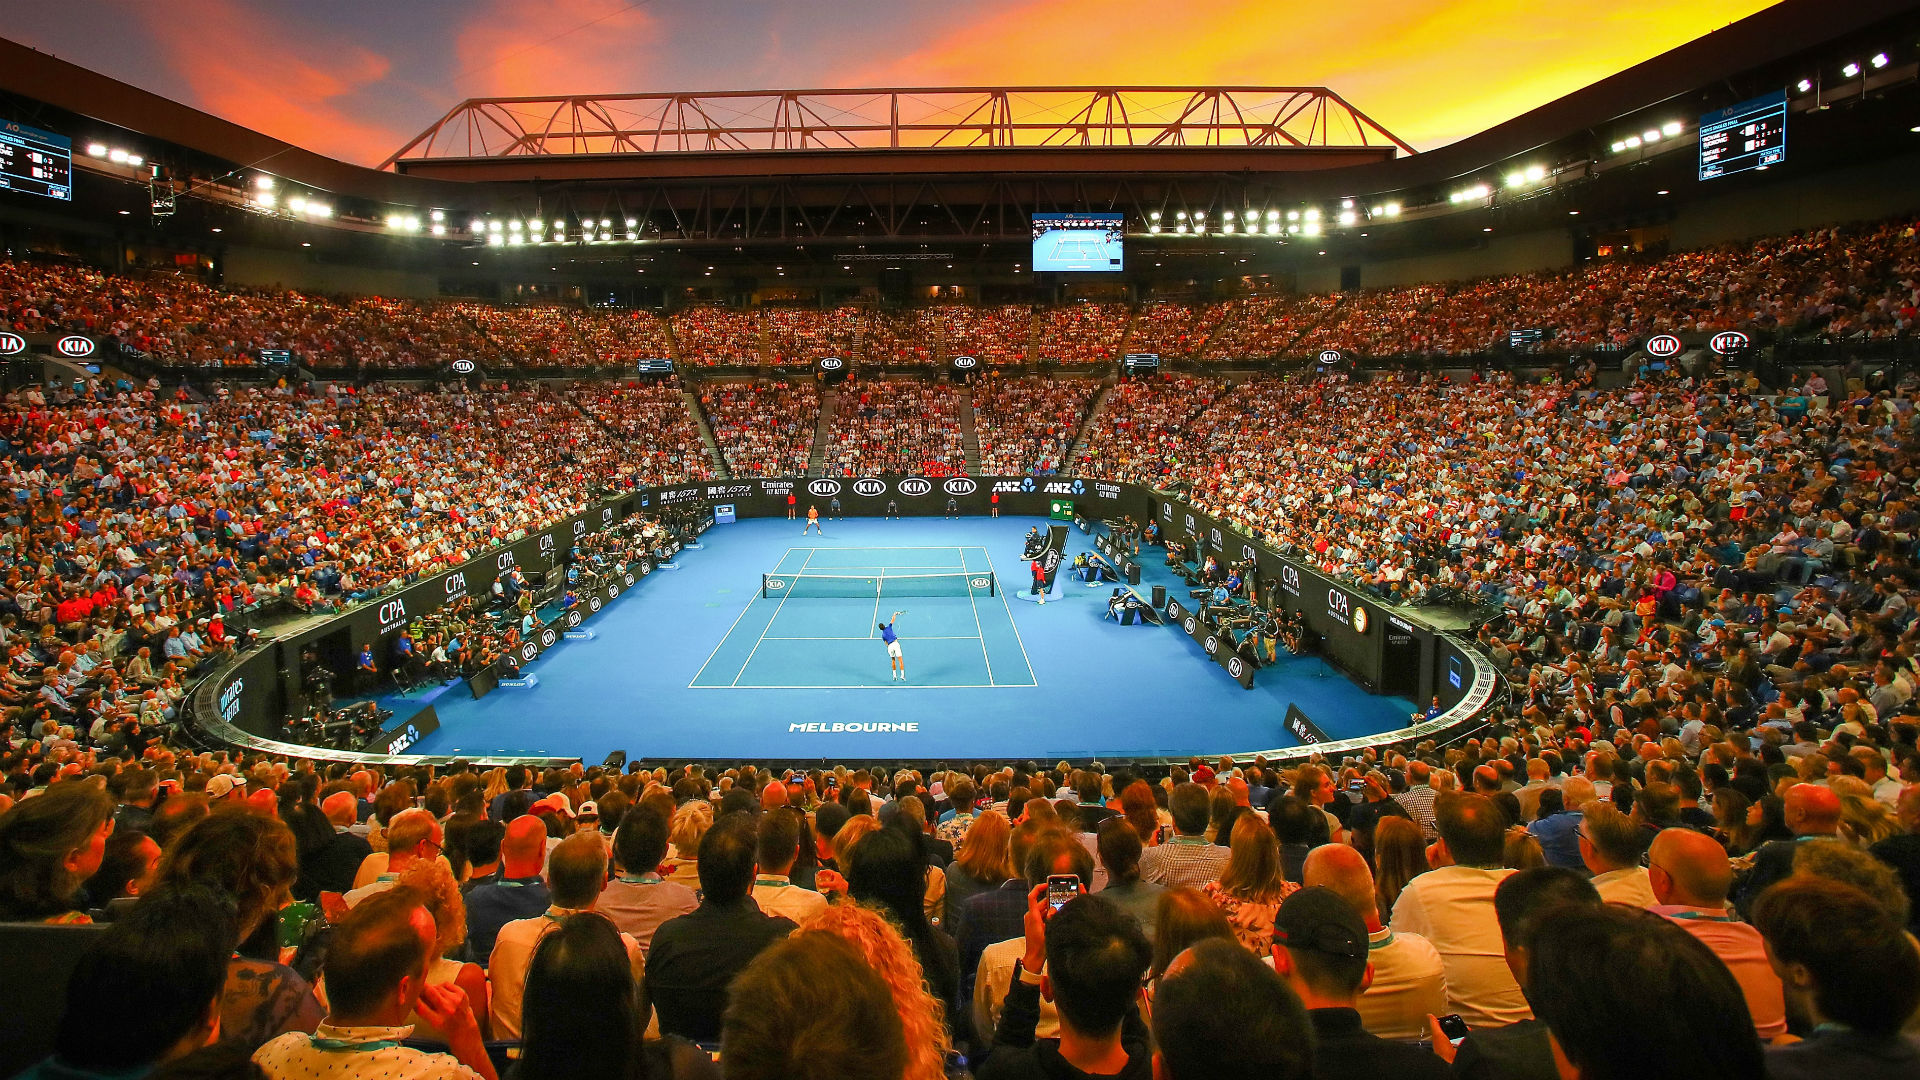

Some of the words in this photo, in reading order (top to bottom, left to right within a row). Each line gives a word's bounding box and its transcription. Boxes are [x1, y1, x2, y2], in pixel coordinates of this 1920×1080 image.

[6, 123, 19, 132] AO
[64, 341, 89, 352] KIA
[1652, 340, 1674, 352] KIA
[814, 483, 835, 492] KIA
[859, 483, 880, 492] KIA
[904, 483, 926, 492] KIA
[950, 482, 971, 491] KIA
[992, 482, 1020, 492] ANZ
[1044, 482, 1071, 493] ANZ
[574, 520, 585, 534] CPA
[540, 534, 554, 550] CPA
[1212, 528, 1222, 546] CPA
[497, 551, 514, 569] CPA
[445, 572, 466, 594] CPA
[1283, 565, 1299, 588] CPA
[1328, 589, 1348, 616] CPA
[379, 598, 406, 624] CPA
[380, 619, 406, 634] AUSTRALIA
[788, 722, 919, 733] MELBOURNE
[388, 734, 410, 755] ANZ
